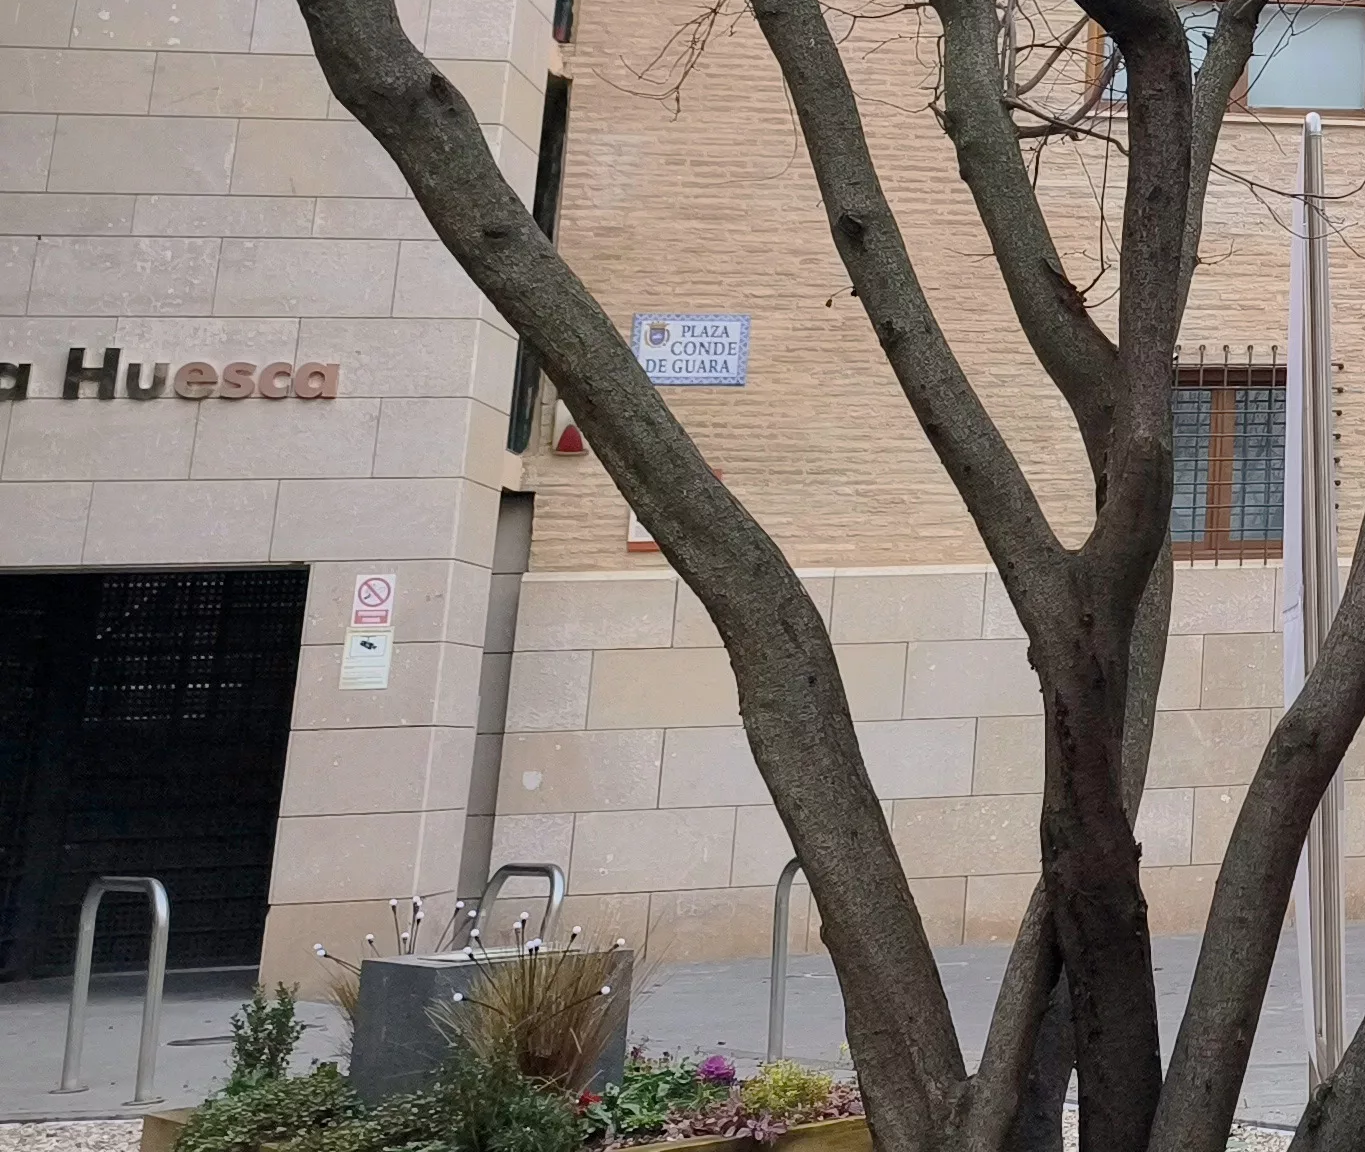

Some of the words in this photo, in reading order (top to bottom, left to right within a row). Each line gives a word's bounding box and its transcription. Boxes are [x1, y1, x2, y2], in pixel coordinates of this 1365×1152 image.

[682, 325, 730, 338] PLAZA
[670, 341, 738, 356] CONDE
[62, 347, 341, 401] Huesca
[645, 359, 667, 373] DE
[671, 359, 730, 374] GUARA
